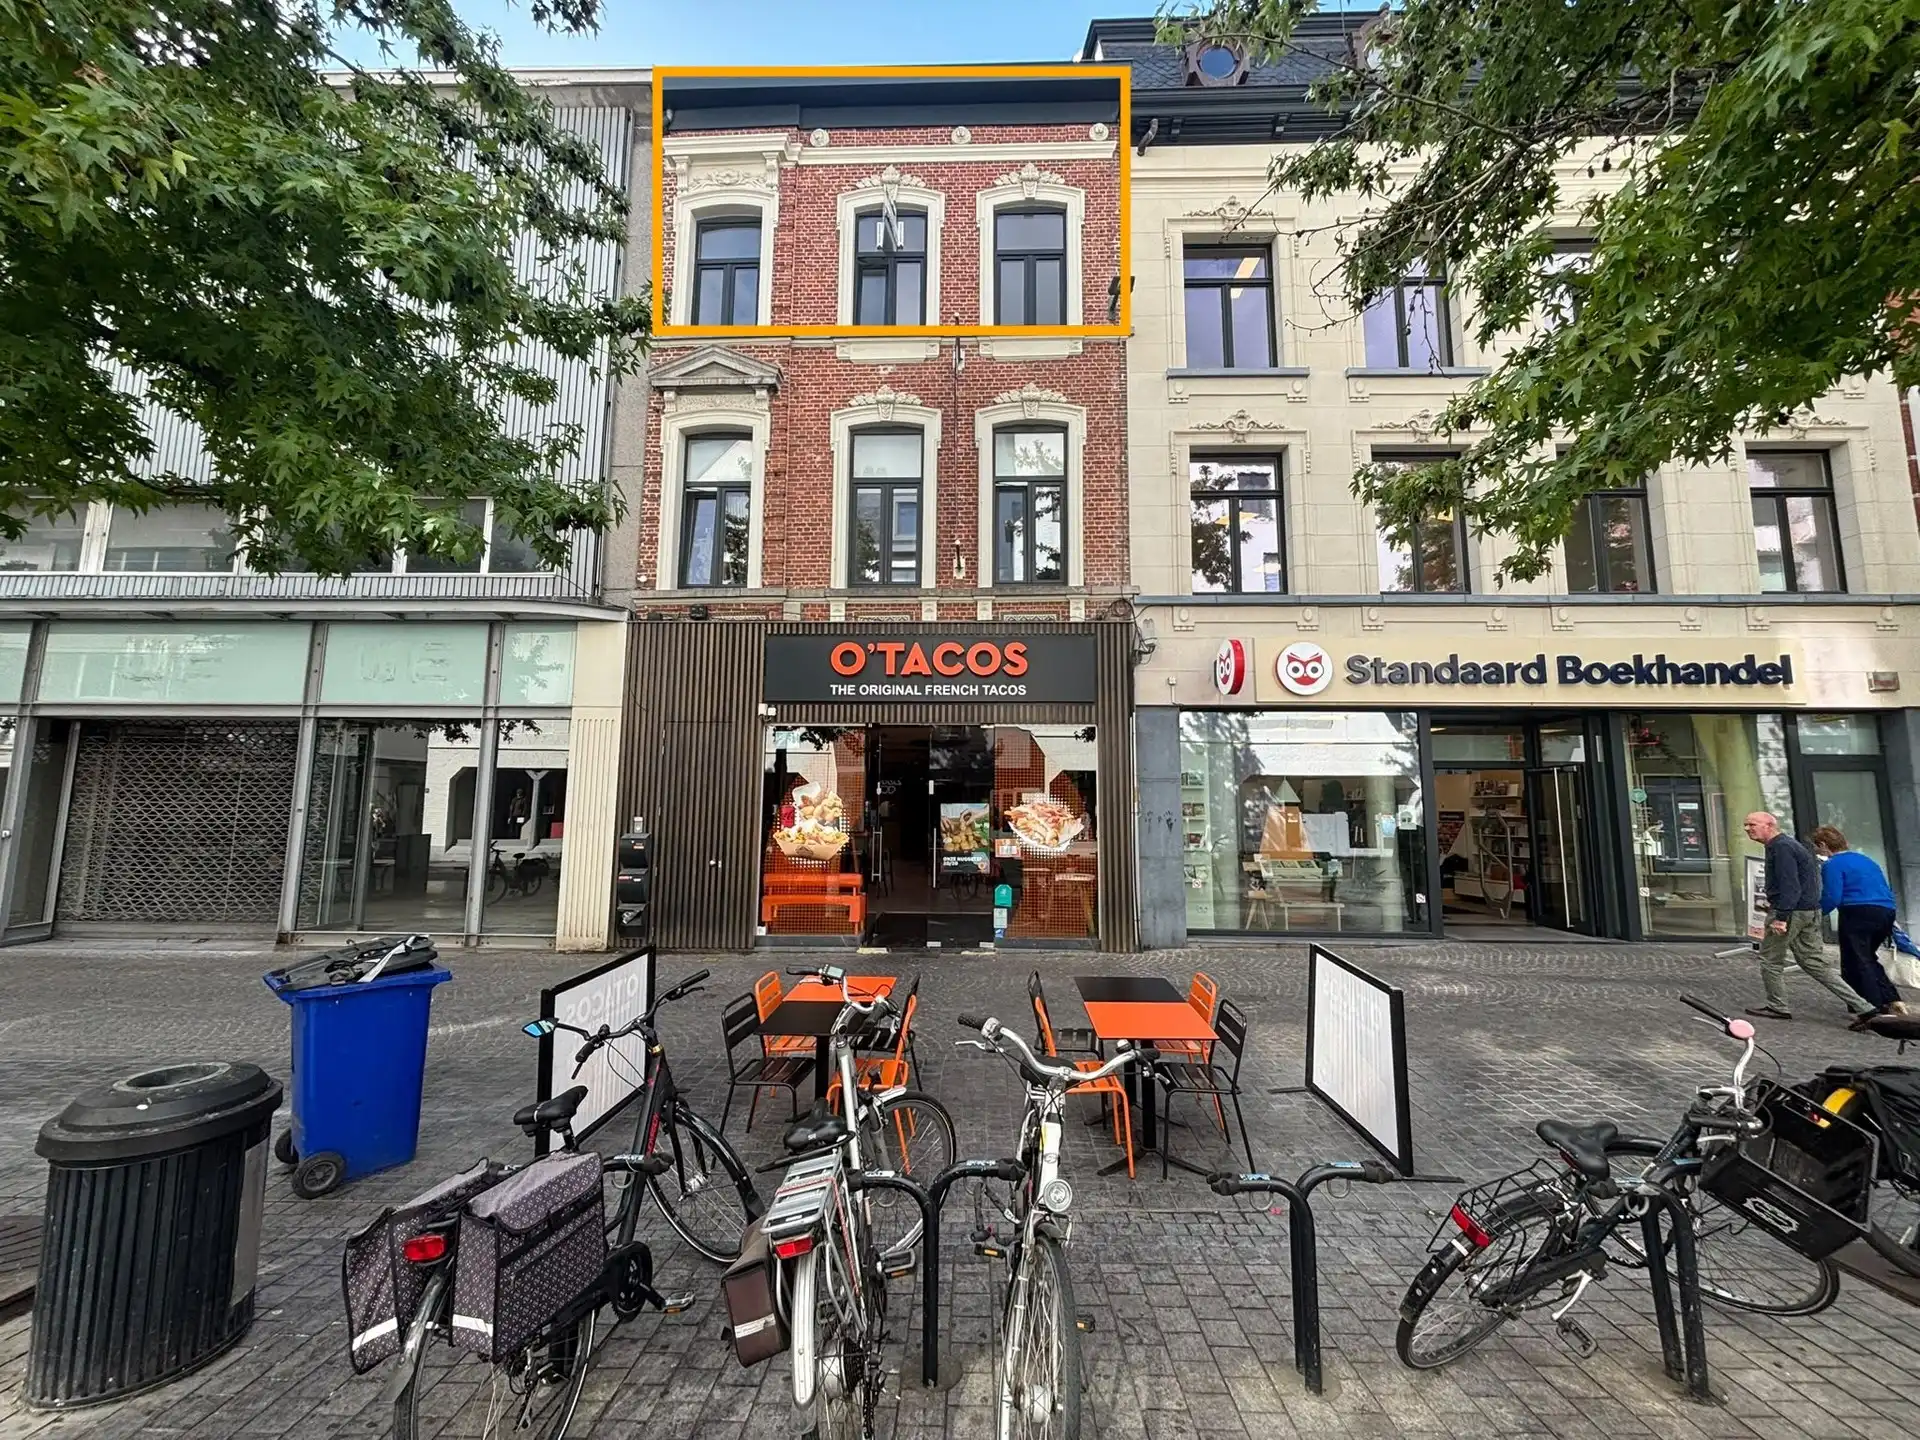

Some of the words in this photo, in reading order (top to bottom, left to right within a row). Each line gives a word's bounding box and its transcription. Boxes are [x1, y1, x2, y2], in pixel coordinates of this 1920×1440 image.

[831, 642, 1028, 676] O'TACOS
[1345, 653, 1547, 686] Standaard
[1557, 653, 1794, 686] Boekhandel
[830, 684, 856, 696] THE
[859, 684, 922, 696] ORIGINAL
[925, 684, 978, 696] FRENCH
[982, 684, 1027, 696] TACOS
